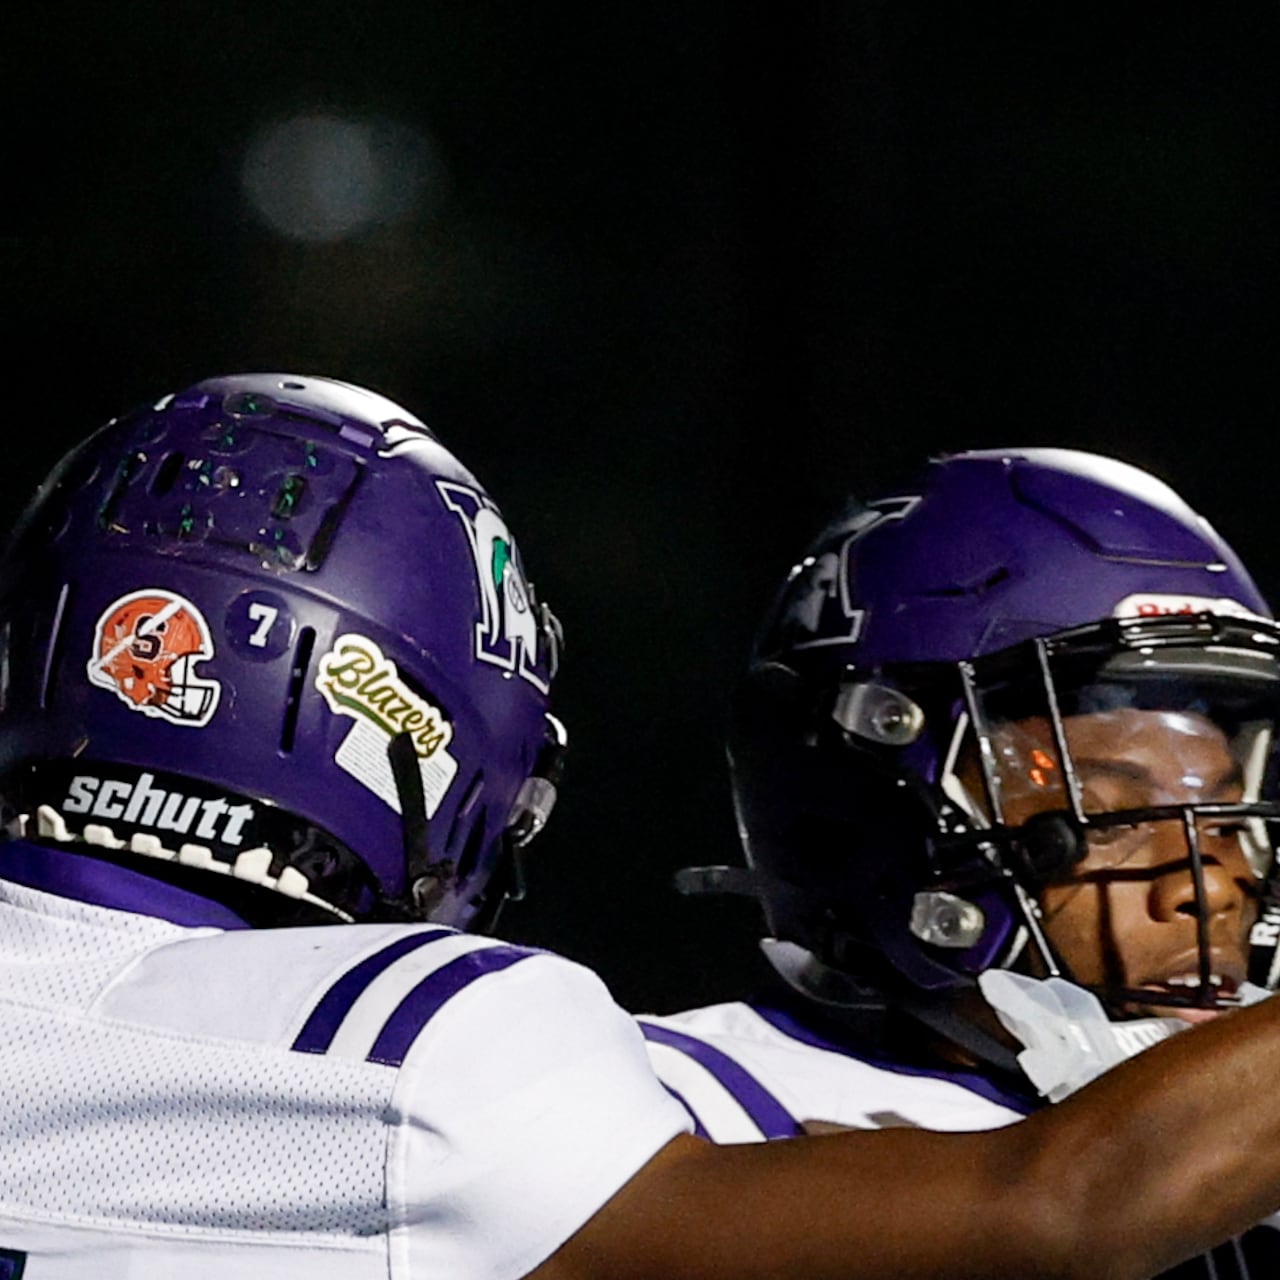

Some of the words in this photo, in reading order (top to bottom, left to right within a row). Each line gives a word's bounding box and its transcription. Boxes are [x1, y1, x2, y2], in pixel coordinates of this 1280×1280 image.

[248, 602, 279, 648] 7
[326, 645, 445, 760] Blazers
[62, 772, 255, 846] schutt
